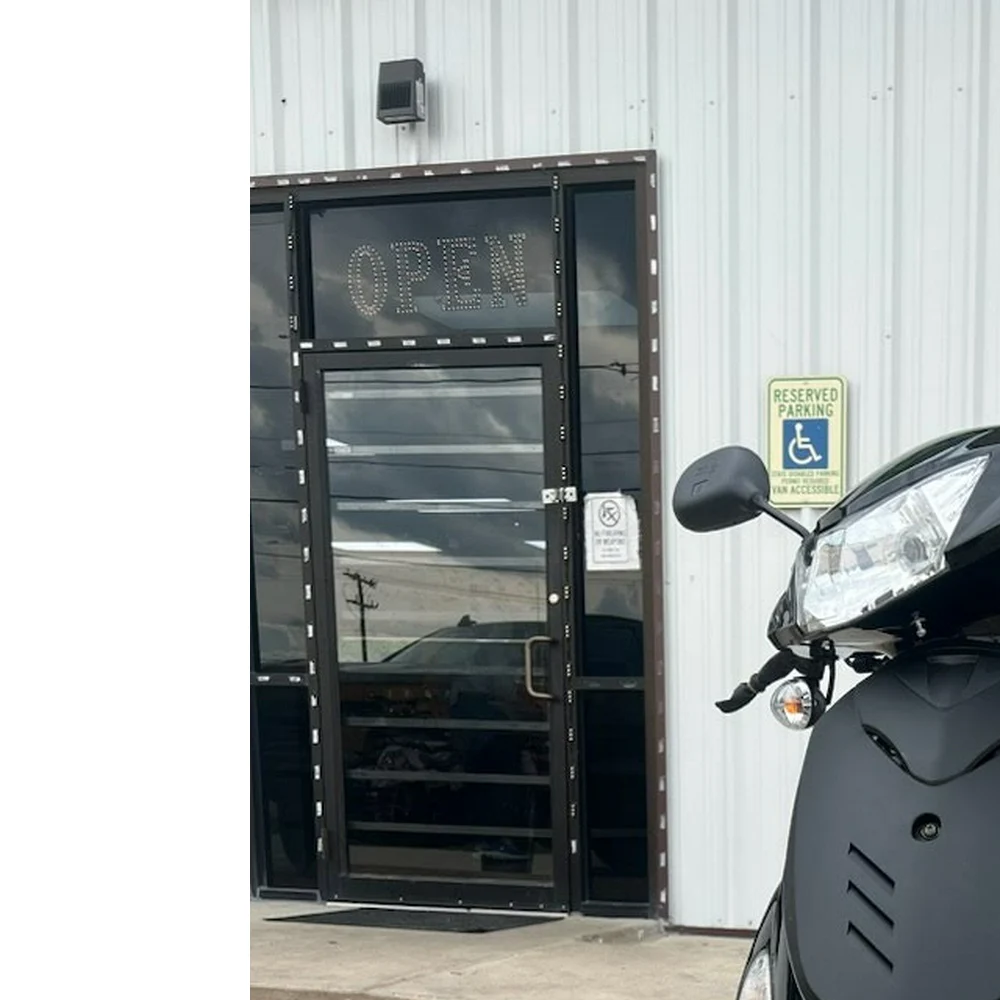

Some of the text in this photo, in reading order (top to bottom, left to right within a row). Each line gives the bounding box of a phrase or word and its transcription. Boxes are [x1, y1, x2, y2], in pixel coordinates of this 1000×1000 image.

[348, 233, 527, 316] OPEN
[773, 388, 838, 403] RESERVED
[778, 403, 834, 418] PARKING
[772, 485, 839, 494] VAN ACCESSIBLE
